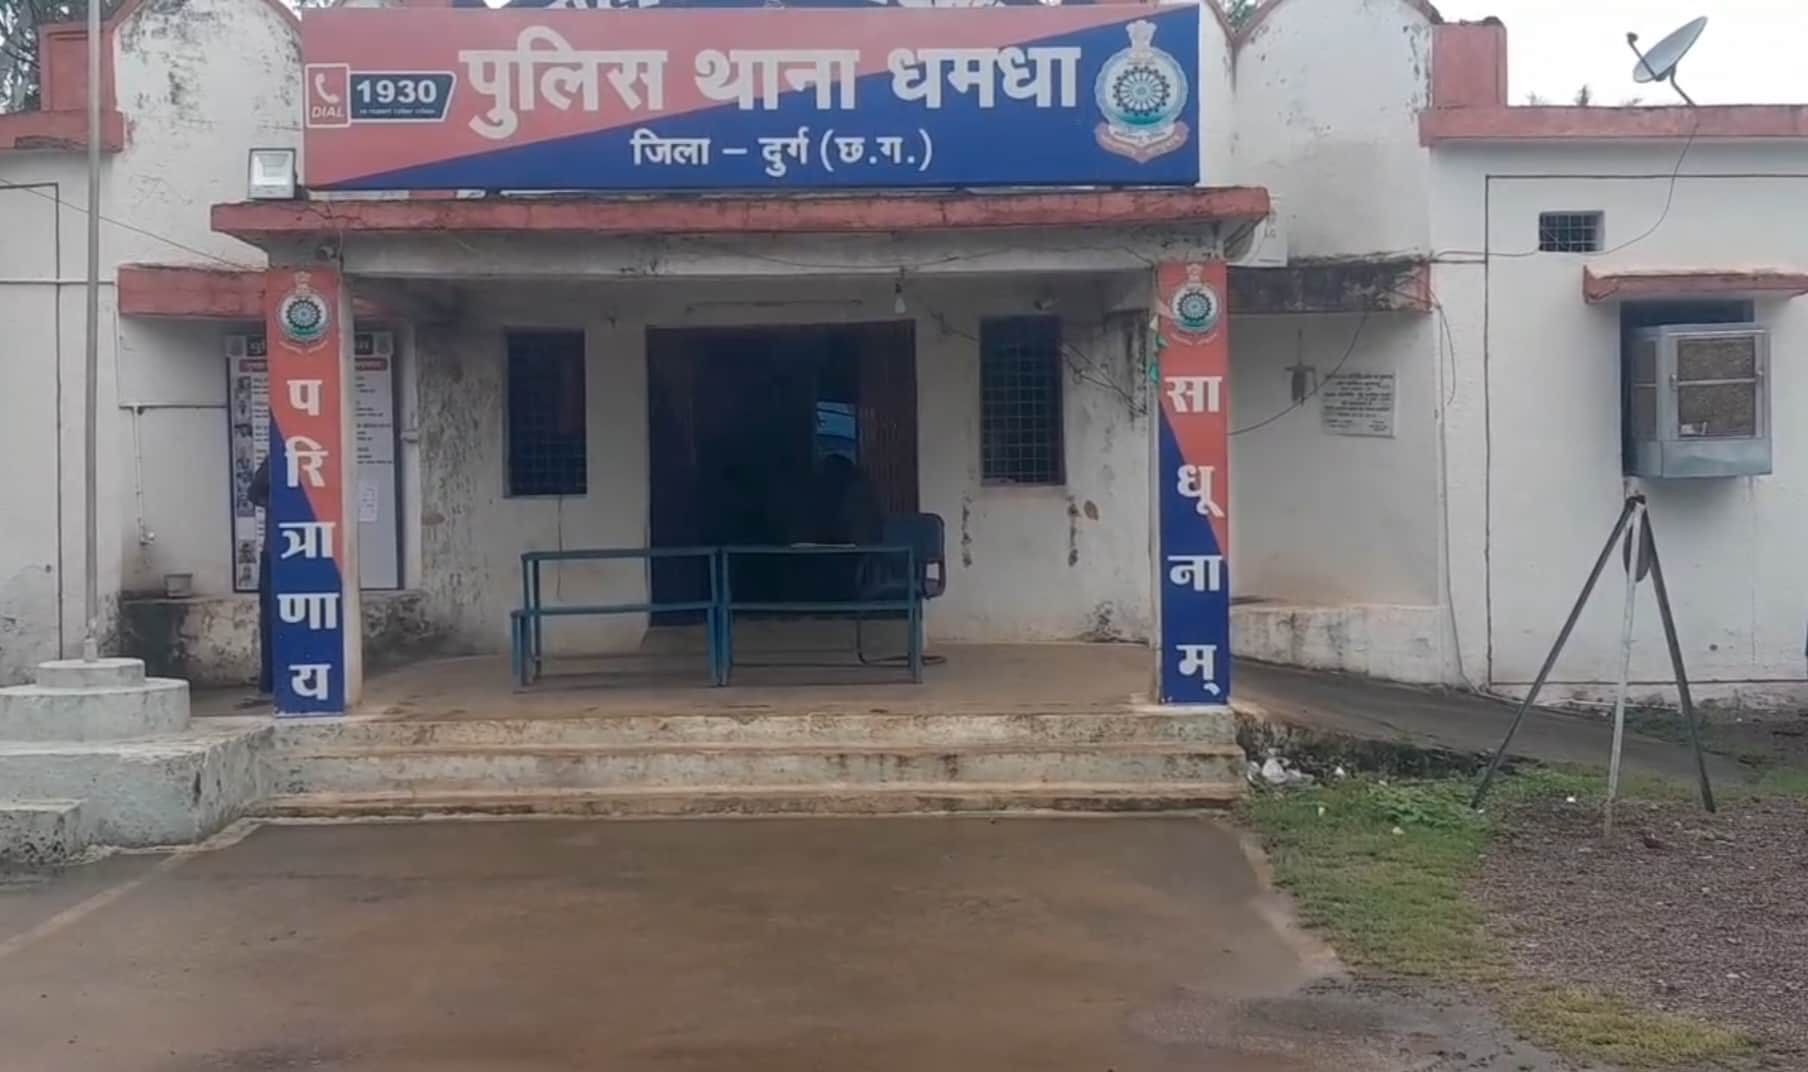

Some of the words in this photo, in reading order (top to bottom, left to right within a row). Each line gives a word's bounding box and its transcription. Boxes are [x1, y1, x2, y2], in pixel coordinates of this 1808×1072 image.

[356, 80, 437, 103] 1930
[458, 25, 668, 139] पुलिस
[695, 49, 860, 109] थाना
[887, 47, 1081, 108] धमधा
[311, 106, 344, 118] DIAL
[630, 128, 711, 164] जिला
[757, 126, 810, 177] दुर्ग
[820, 128, 932, 172] (छ.ग.)
